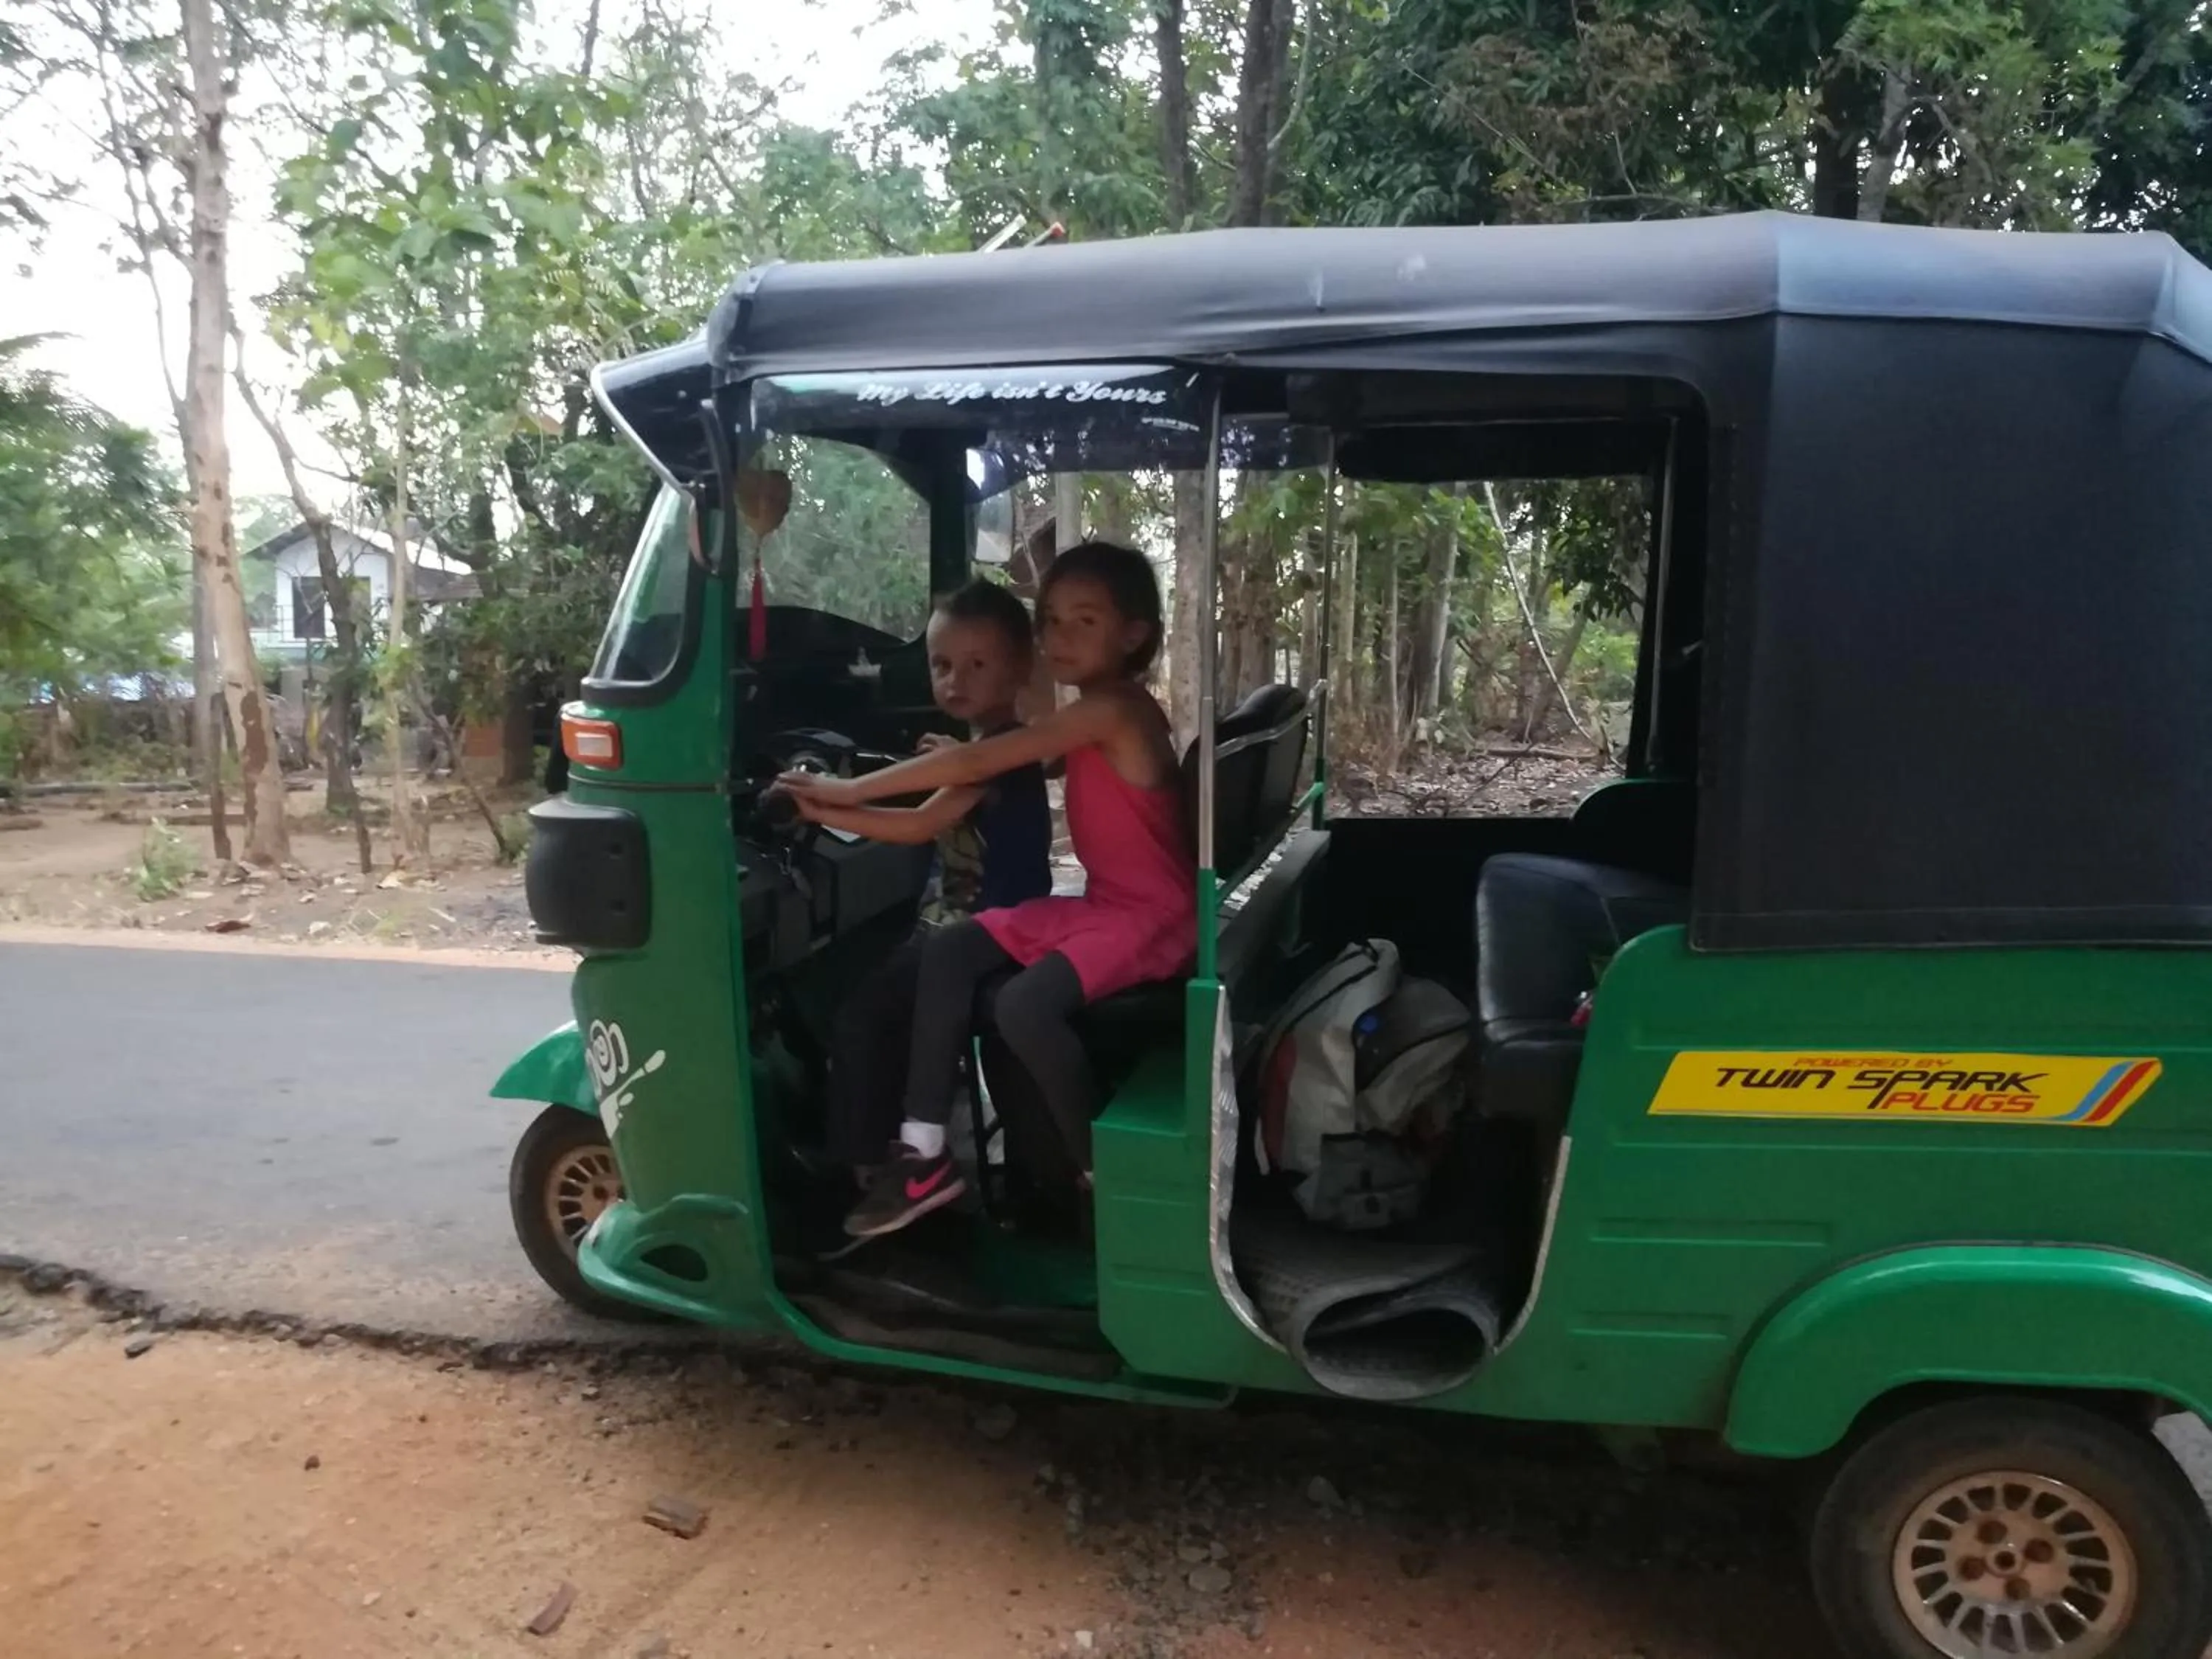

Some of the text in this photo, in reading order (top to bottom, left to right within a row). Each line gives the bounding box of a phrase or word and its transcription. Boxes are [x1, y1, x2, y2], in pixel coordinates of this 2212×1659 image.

[856, 382, 909, 407] My
[914, 380, 986, 406] Life
[1065, 380, 1167, 405] Yours
[1792, 1057, 1954, 1068] POWERED BY
[1715, 1067, 2050, 1110] TWIN SPARK
[1880, 1091, 2042, 1113] PLUGS
